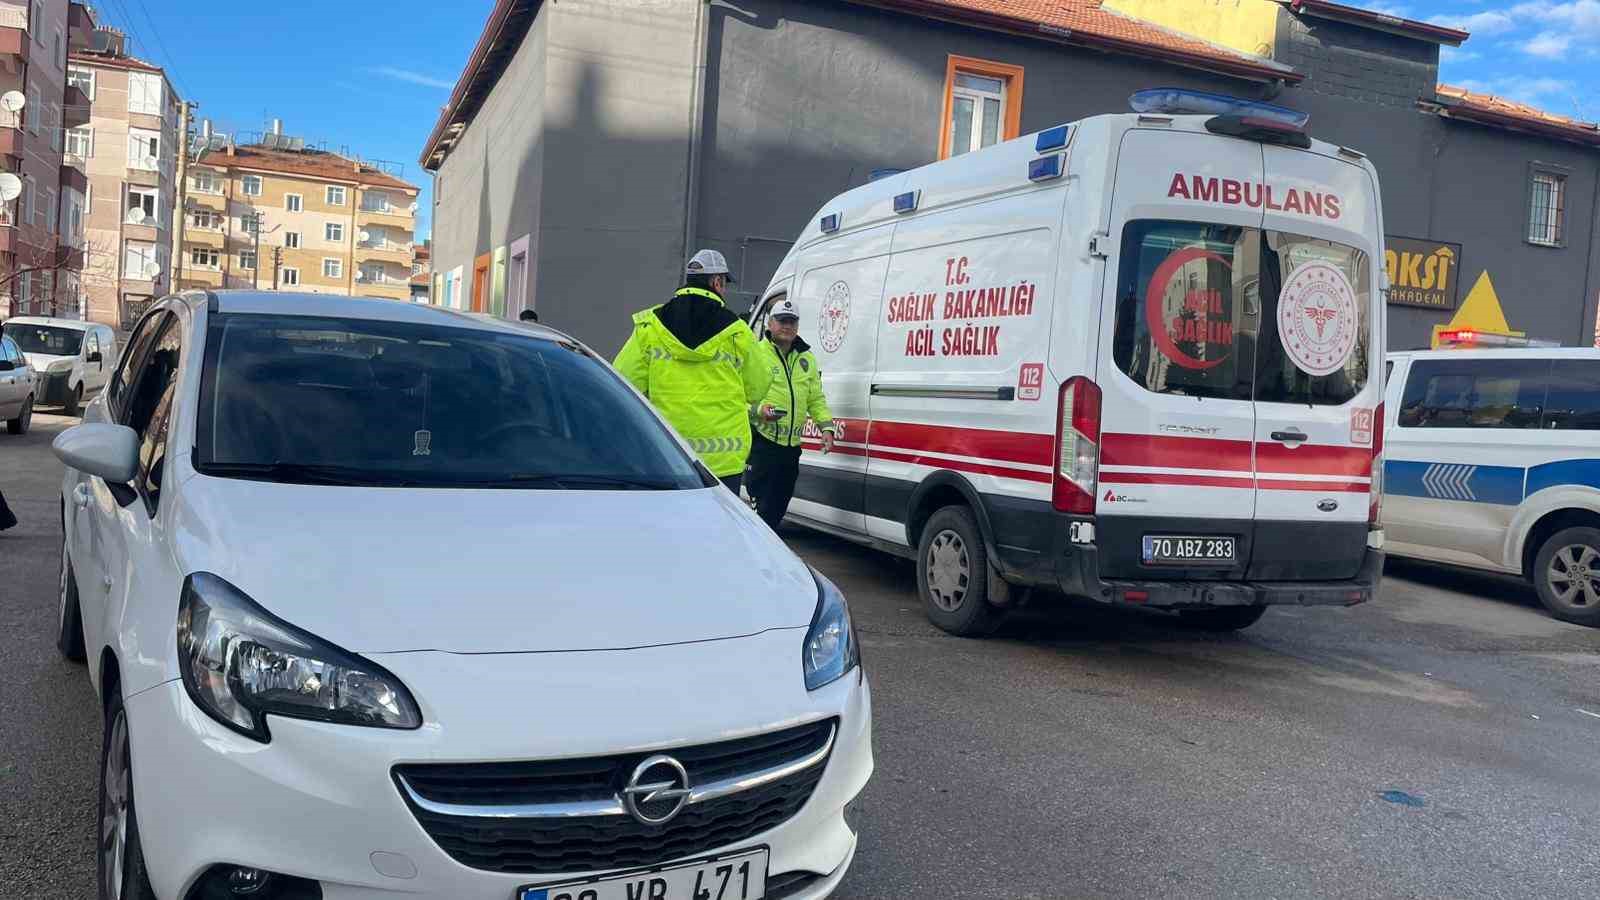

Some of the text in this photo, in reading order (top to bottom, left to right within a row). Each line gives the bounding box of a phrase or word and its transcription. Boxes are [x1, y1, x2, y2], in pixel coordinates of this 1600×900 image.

[1168, 173, 1341, 219] AMBULANS
[945, 256, 970, 286] T.C.
[887, 280, 1036, 323] SAĞLIK BAKANLIĞI
[905, 322, 1000, 356] ACİL SAĞLIK
[1023, 367, 1040, 385] 112
[1353, 411, 1369, 430] 112
[1153, 539, 1232, 557] 70 ABZ 283
[692, 861, 750, 900] 471
